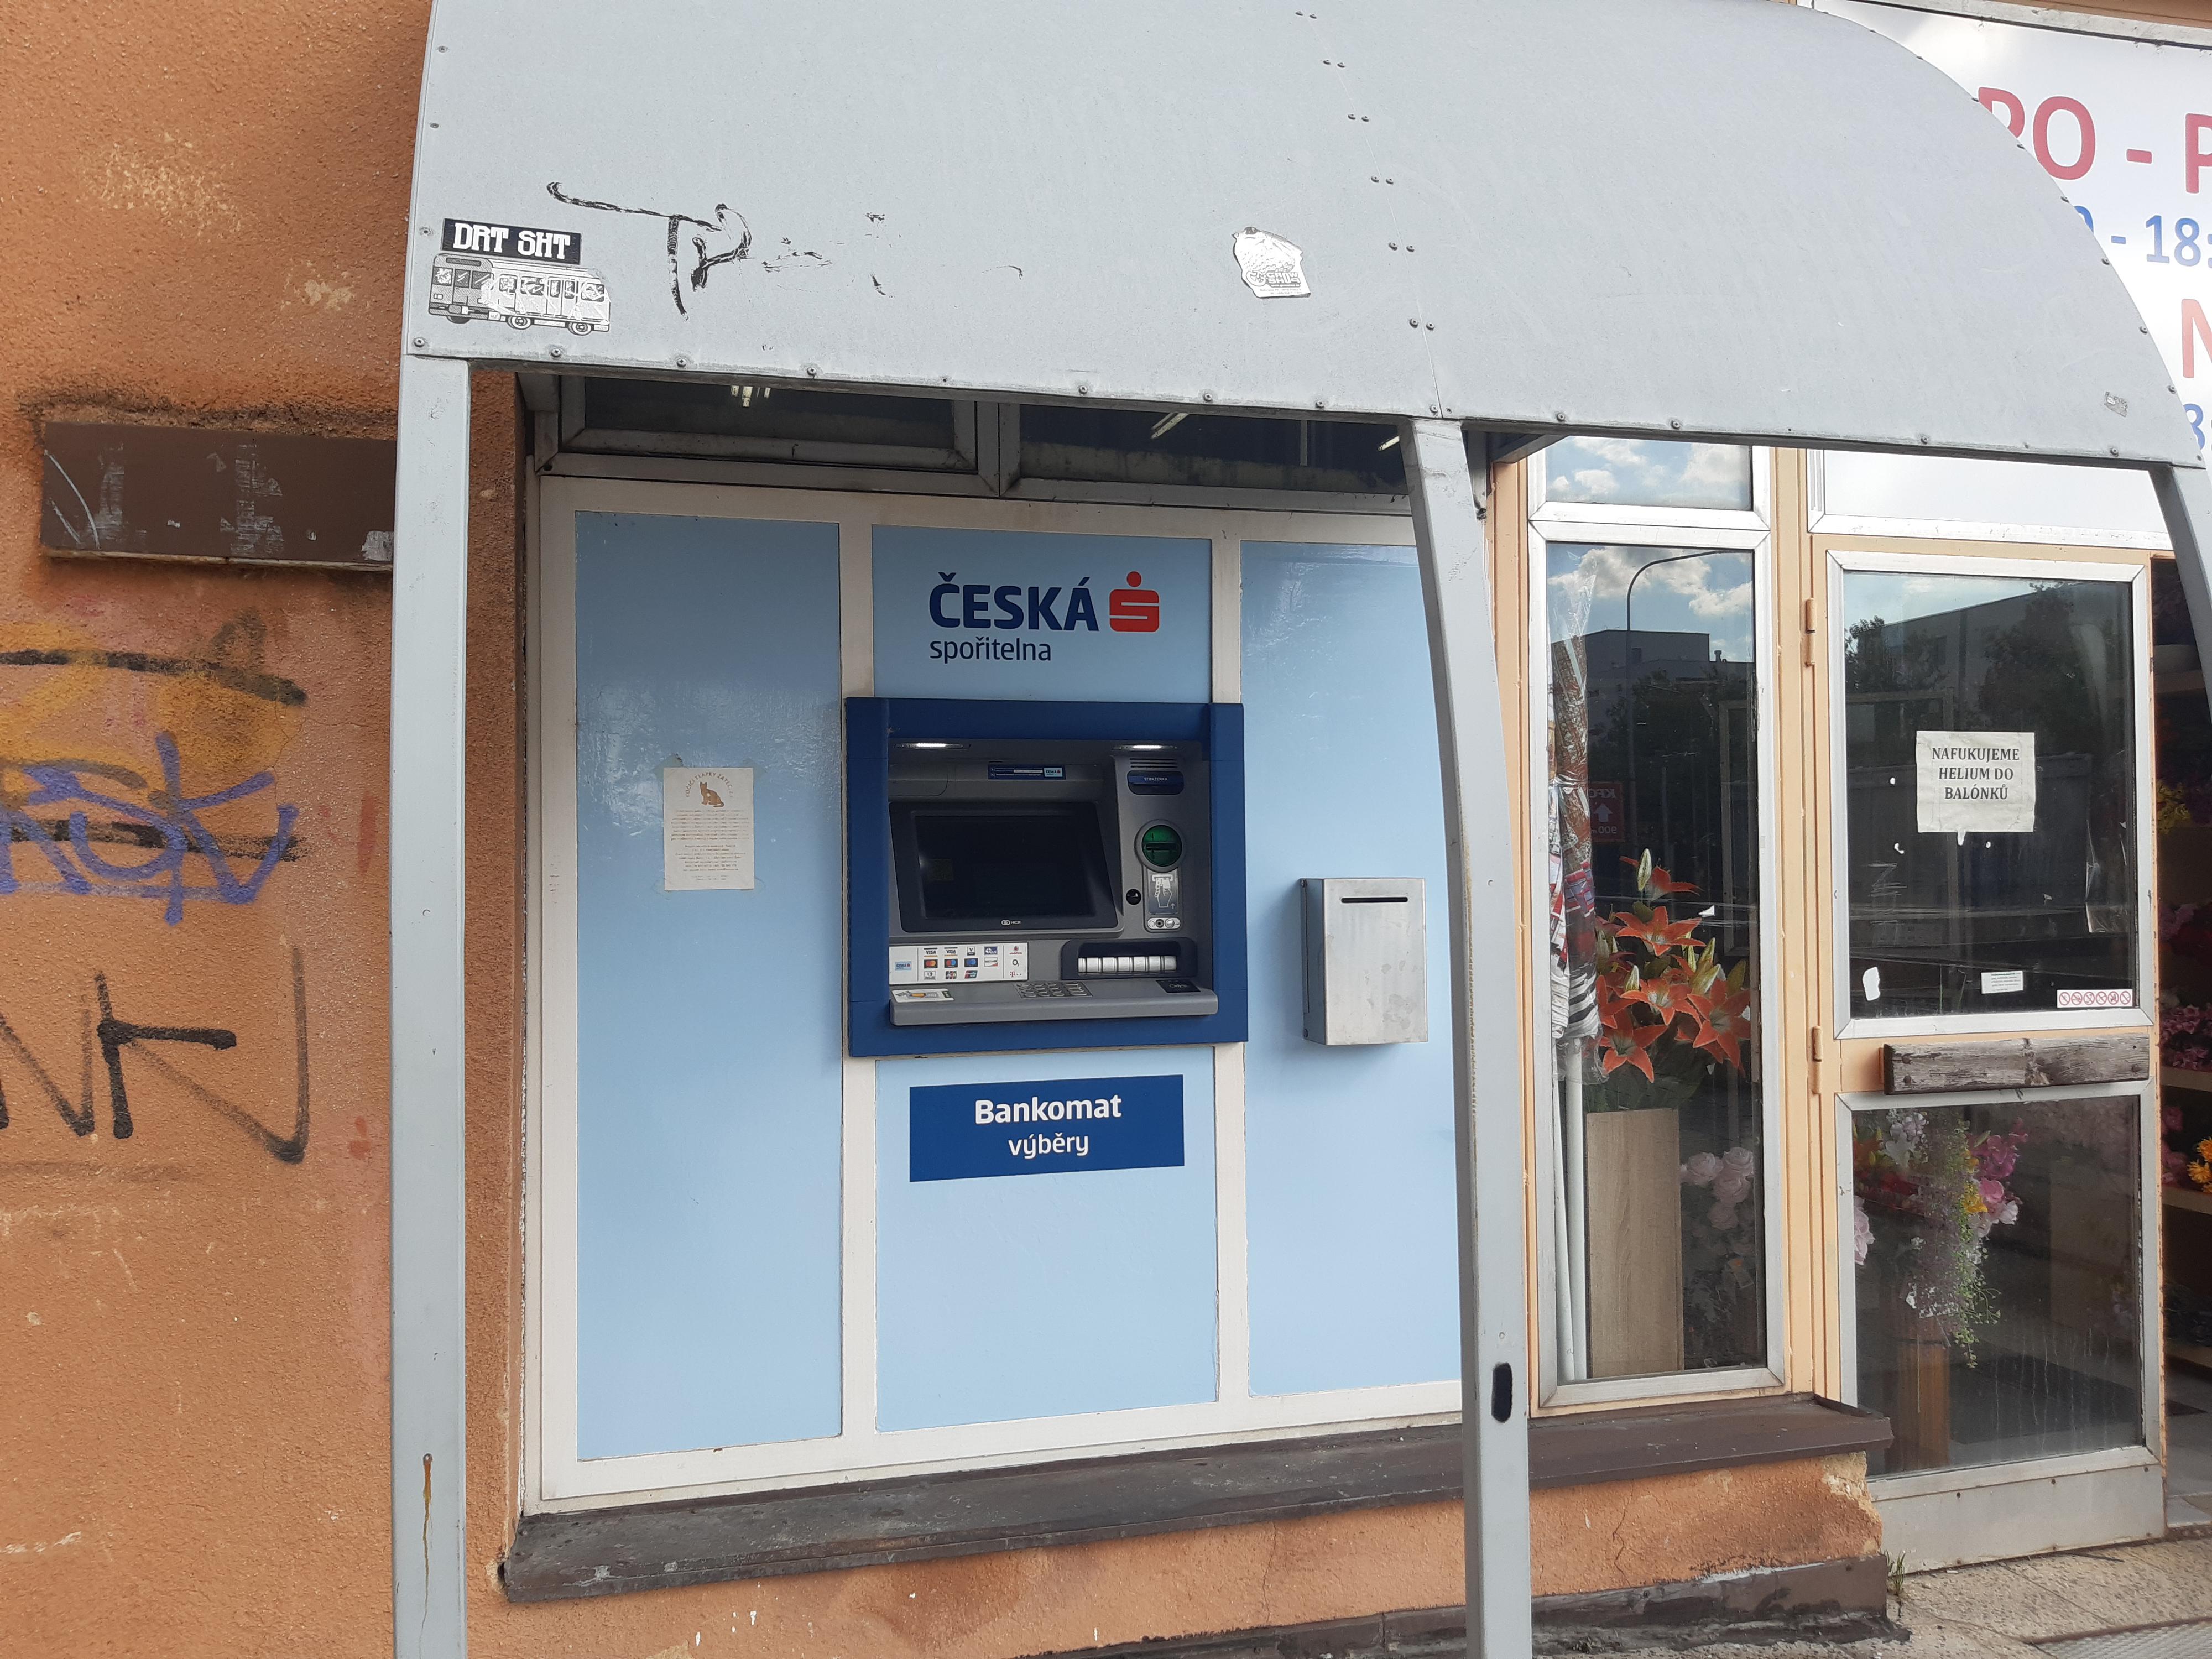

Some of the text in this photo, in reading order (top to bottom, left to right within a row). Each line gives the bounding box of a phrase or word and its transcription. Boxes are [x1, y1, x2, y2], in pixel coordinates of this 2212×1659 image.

[453, 222, 571, 259] DRT SHT
[929, 572, 1099, 631] ČESKÁ
[930, 637, 1051, 664] spořitelna
[1932, 747, 2020, 763] NAFUKUJEME
[1938, 767, 2014, 780] HELIUM DO
[1944, 784, 2008, 800] BALÓNKŮ
[975, 1094, 1121, 1124] Bankomat
[1008, 1132, 1089, 1159] výběry
